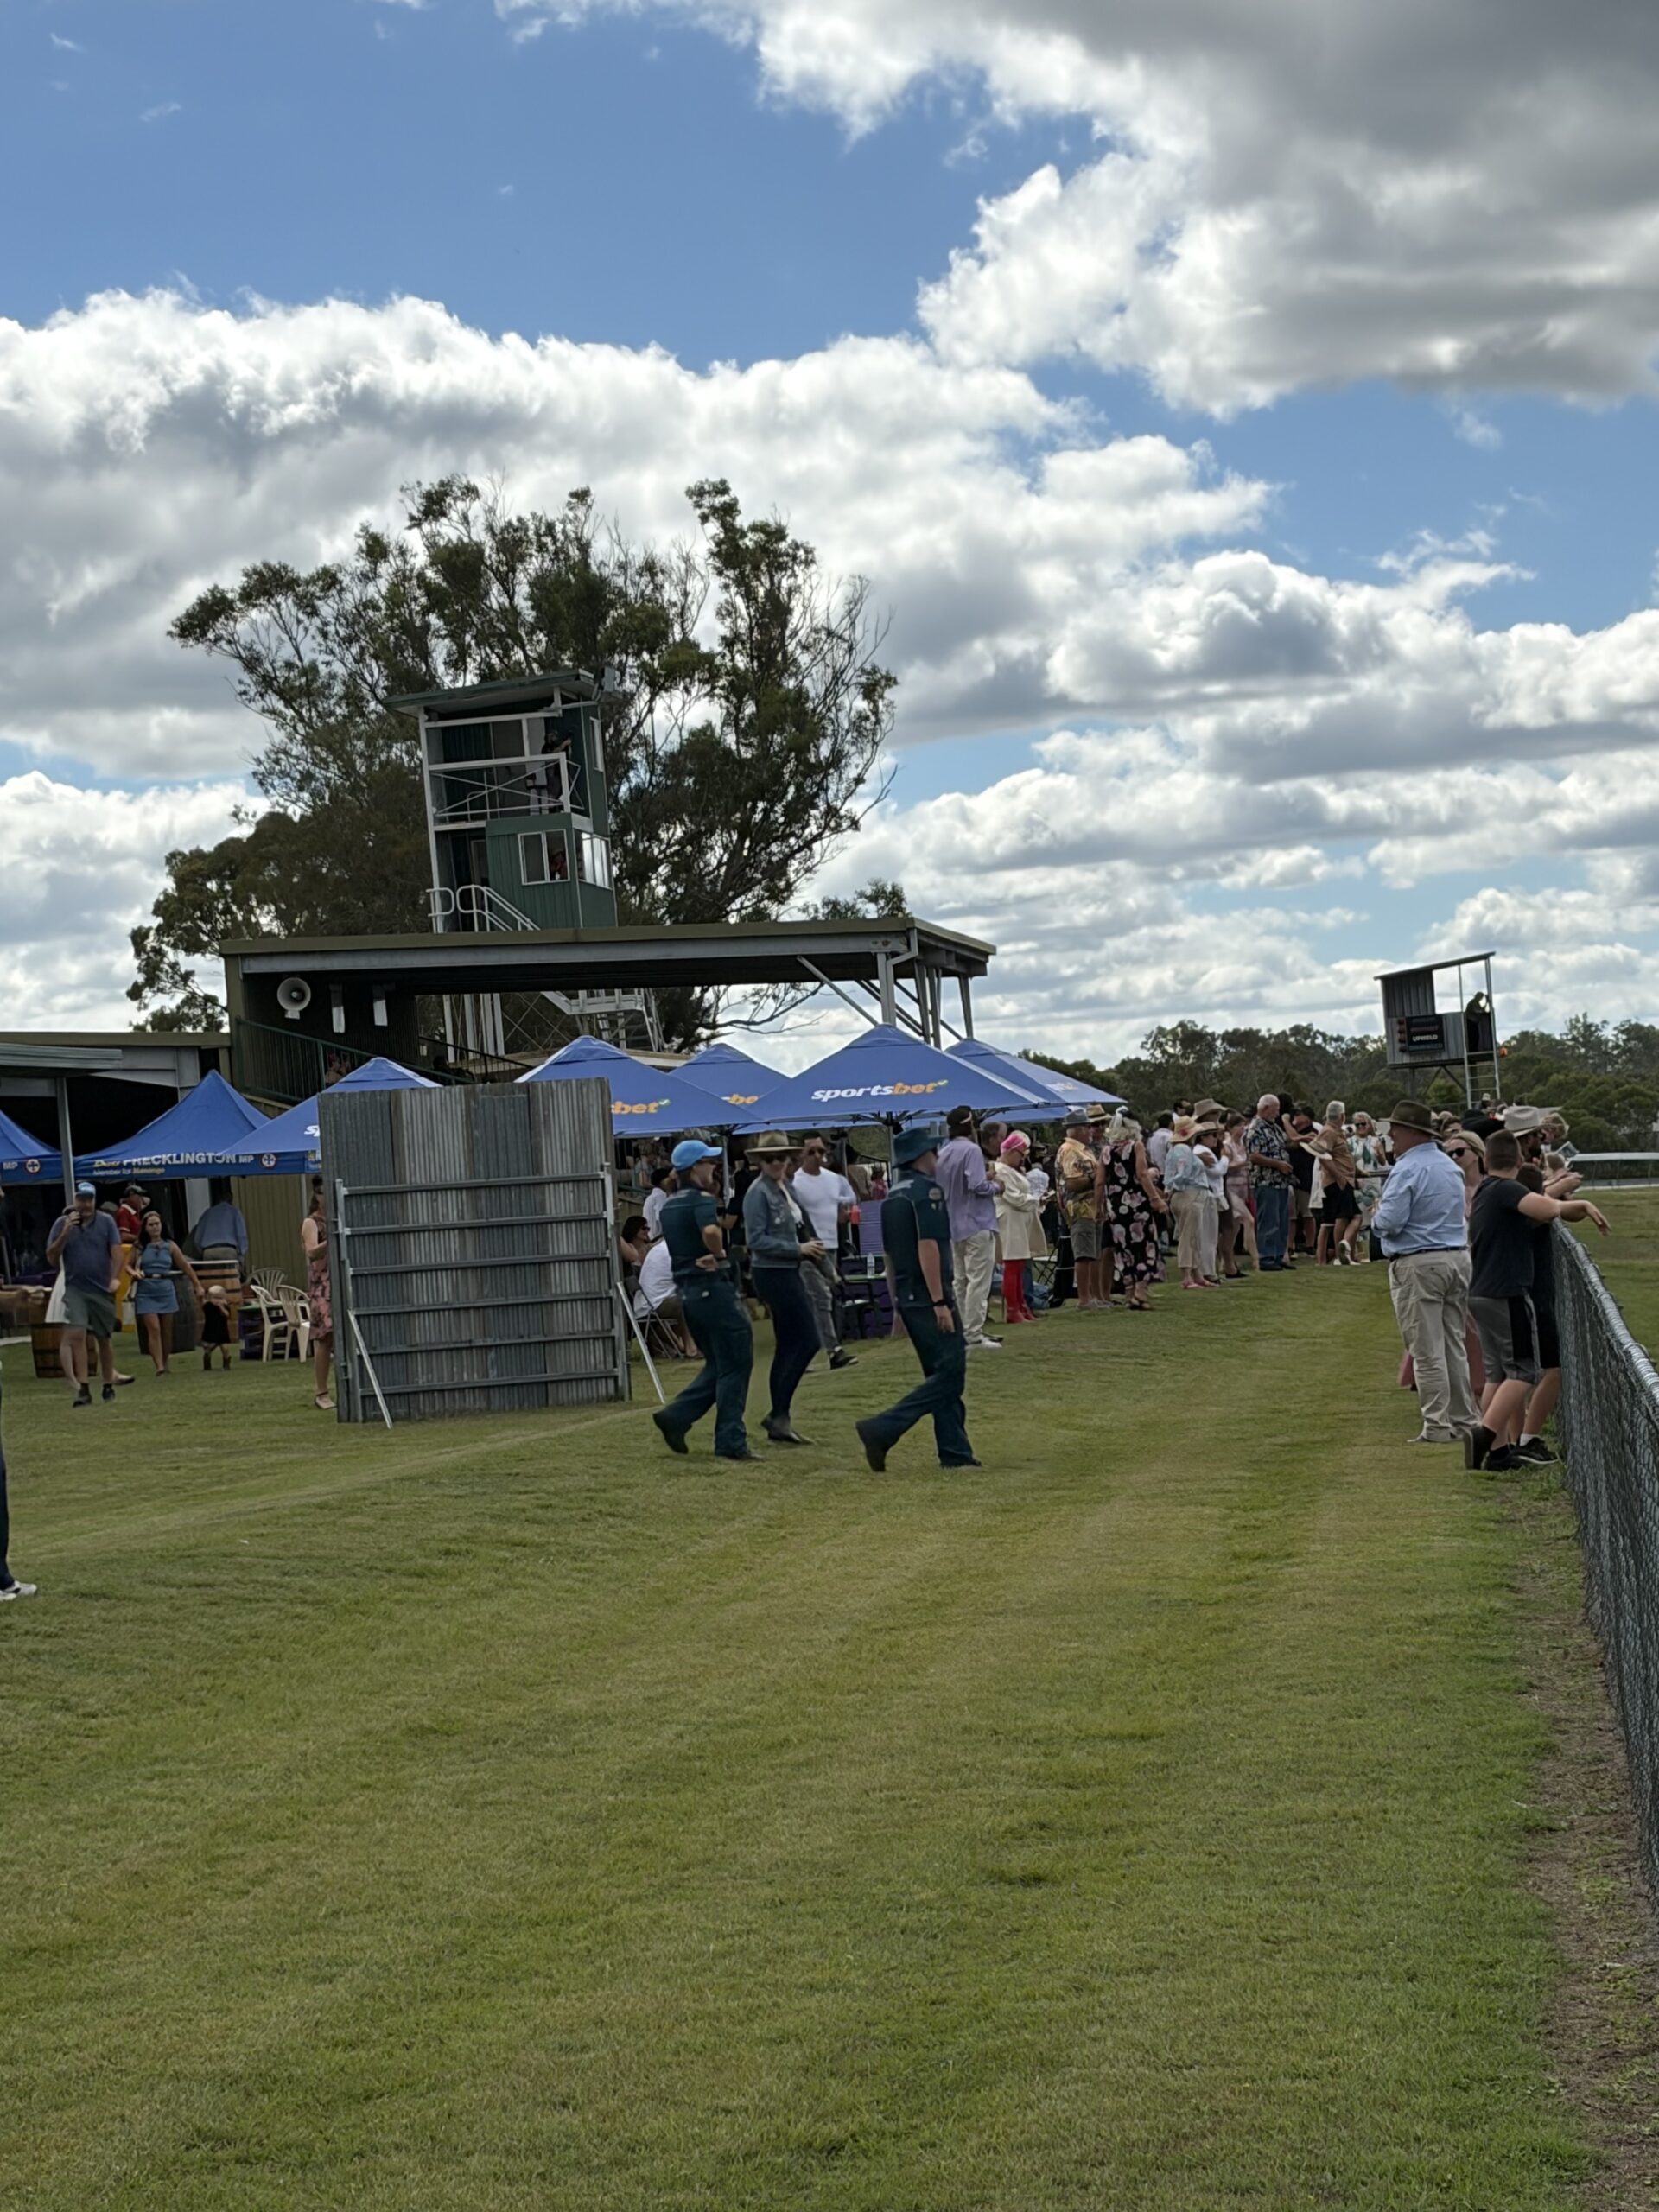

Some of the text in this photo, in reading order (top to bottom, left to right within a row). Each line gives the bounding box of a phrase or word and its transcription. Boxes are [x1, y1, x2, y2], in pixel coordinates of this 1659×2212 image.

[811, 1082, 938, 1102] sportsbet
[123, 1152, 237, 1166] FRECKLINGTON
[238, 1155, 254, 1164] MP
